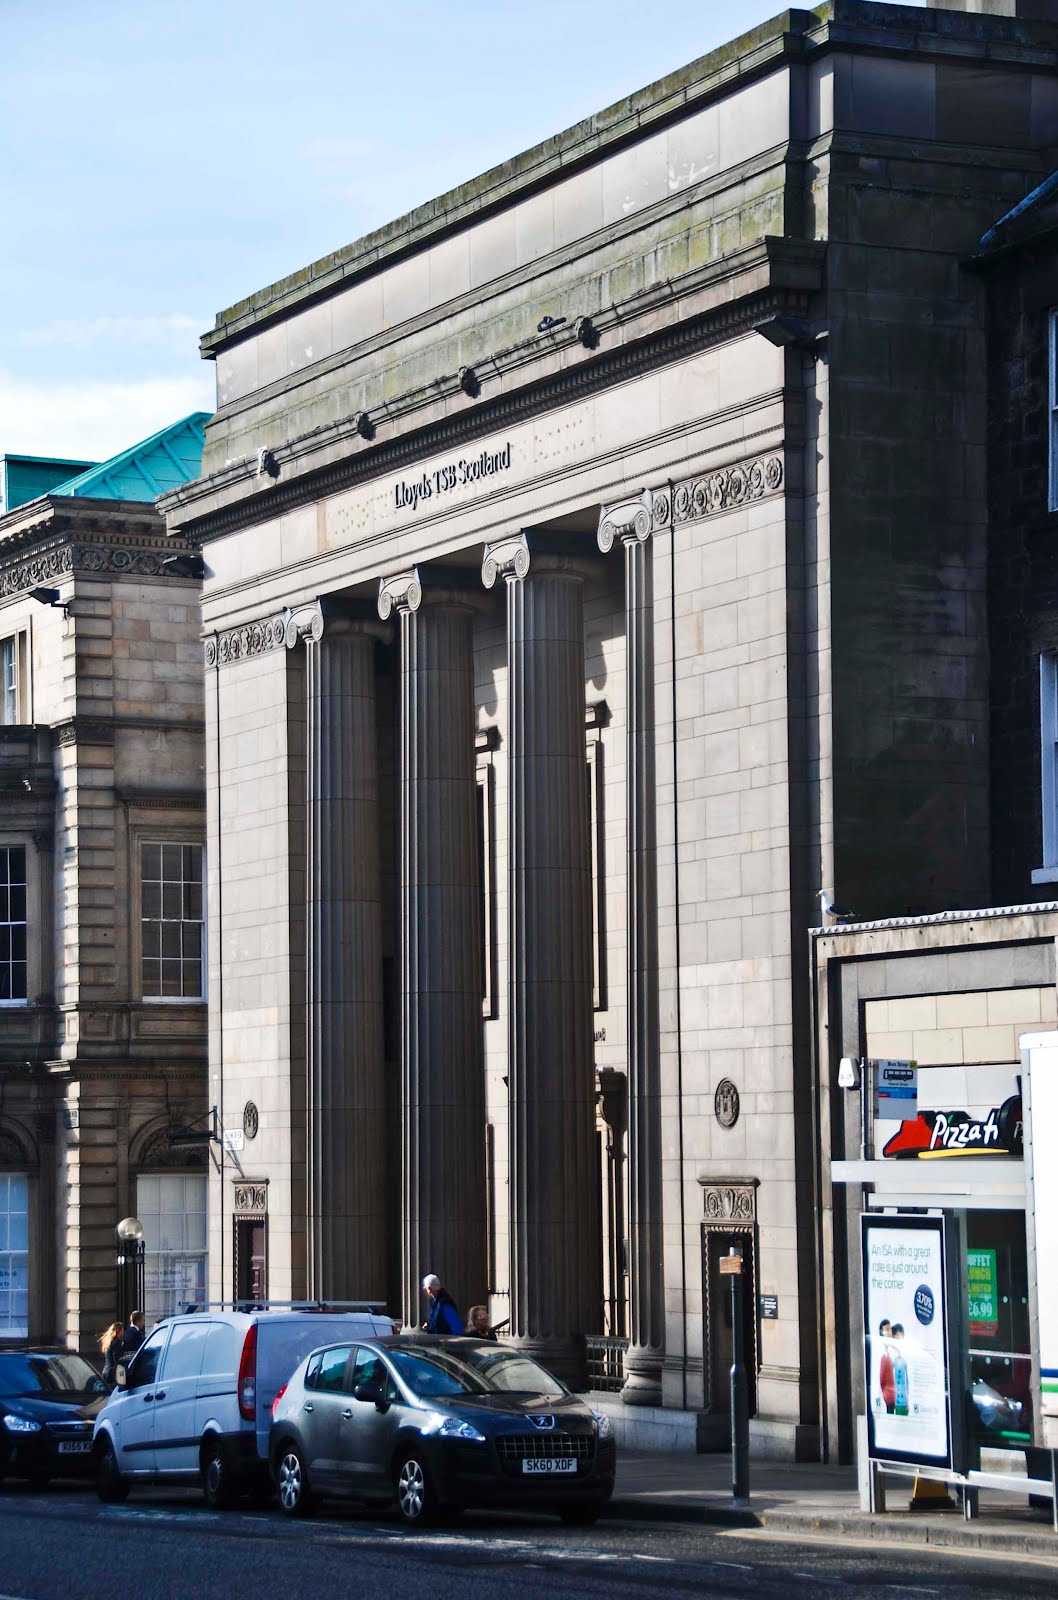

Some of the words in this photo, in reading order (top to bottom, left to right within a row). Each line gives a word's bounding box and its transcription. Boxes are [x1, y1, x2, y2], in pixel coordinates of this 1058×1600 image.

[395, 473, 432, 511] Lloyds
[433, 464, 456, 494] TSB
[459, 442, 511, 484] Scotland
[930, 1113, 981, 1150] Pizza
[872, 1244, 881, 1255] An
[882, 1244, 892, 1256] ISA
[894, 1244, 907, 1257] with
[908, 1248, 912, 1257] a
[914, 1247, 931, 1261] great
[968, 1254, 991, 1267] UFFET
[872, 1262, 885, 1272] rate
[886, 1261, 891, 1272] is
[892, 1262, 904, 1275] just
[904, 1262, 928, 1274] around
[872, 1276, 883, 1289] the
[884, 1278, 904, 1290] corner
[527, 1459, 553, 1471] SK60
[555, 1458, 573, 1470] XDF
